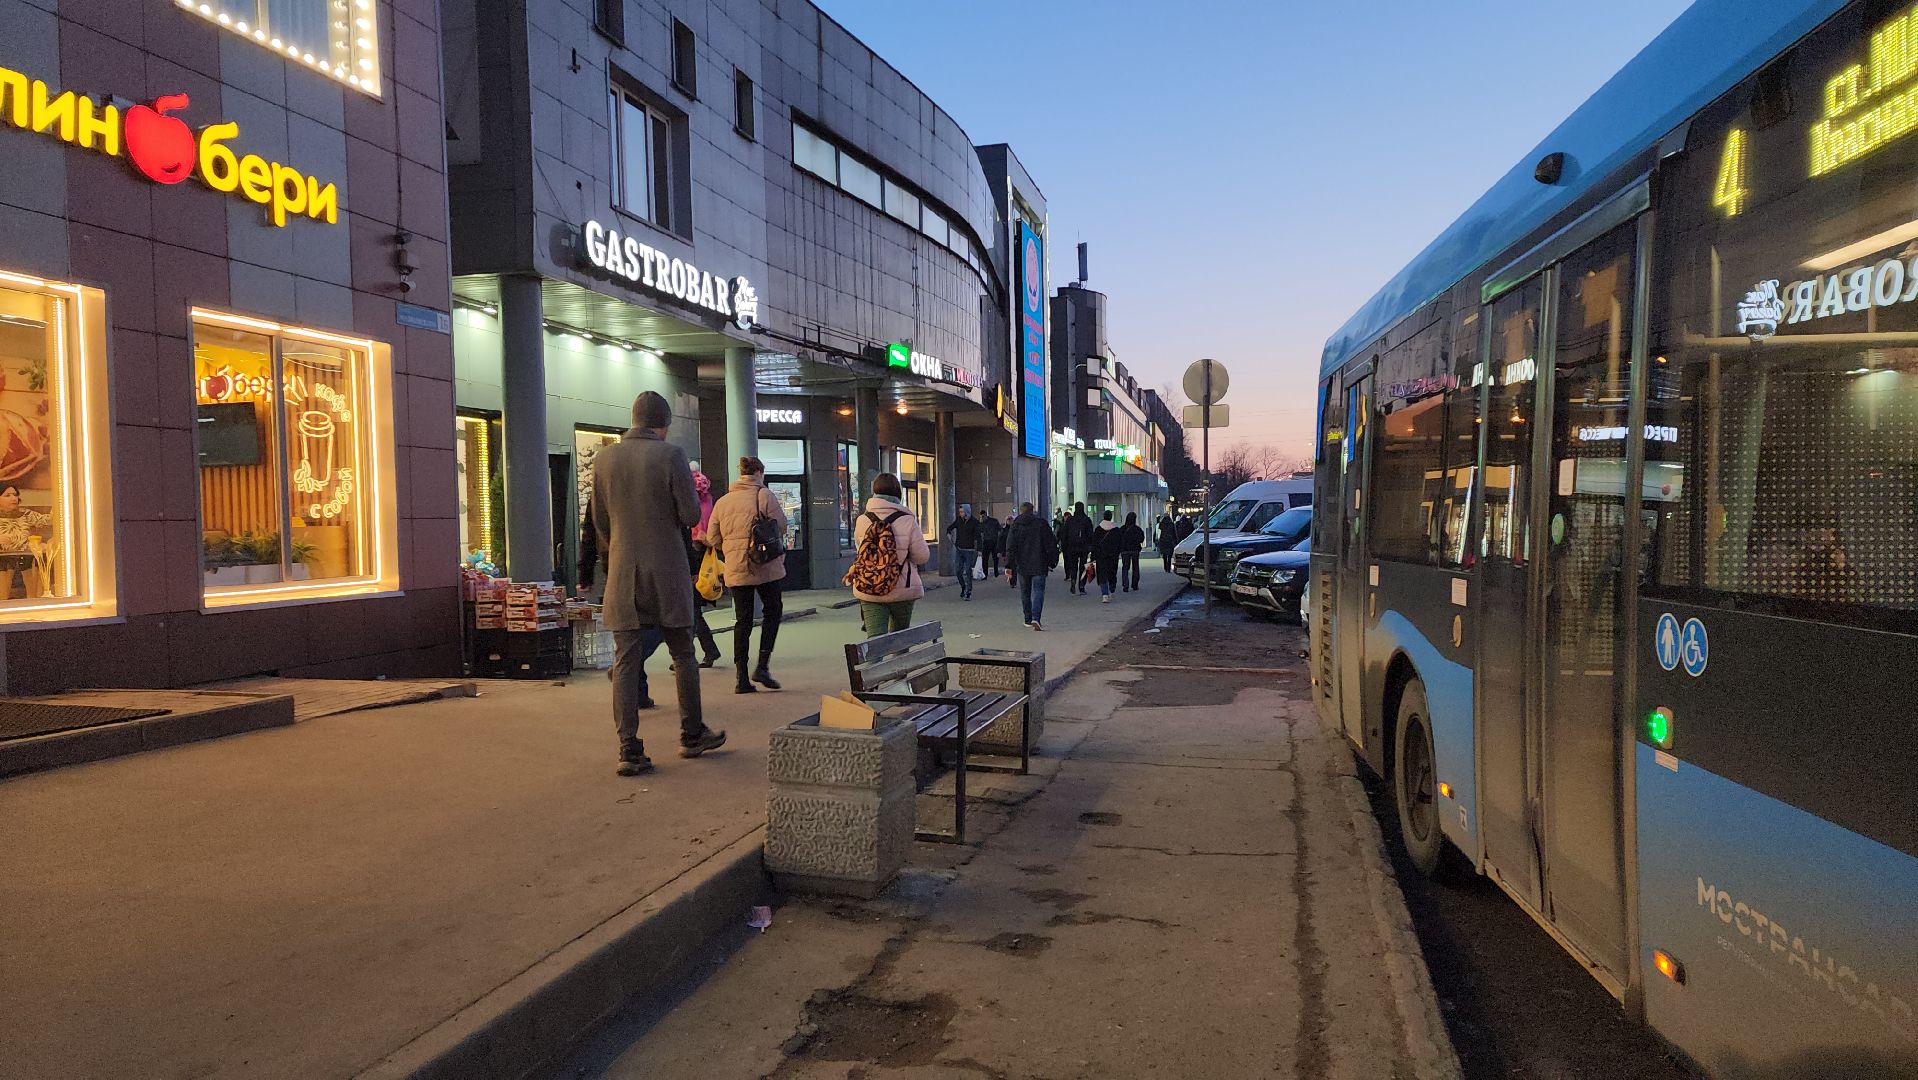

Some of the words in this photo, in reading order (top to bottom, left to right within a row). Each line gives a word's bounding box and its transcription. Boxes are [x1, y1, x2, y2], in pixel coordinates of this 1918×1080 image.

[199, 120, 338, 228] бери
[1712, 127, 1748, 218] 4
[584, 219, 732, 316] GASTROBAR
[910, 351, 943, 380] ОКНА
